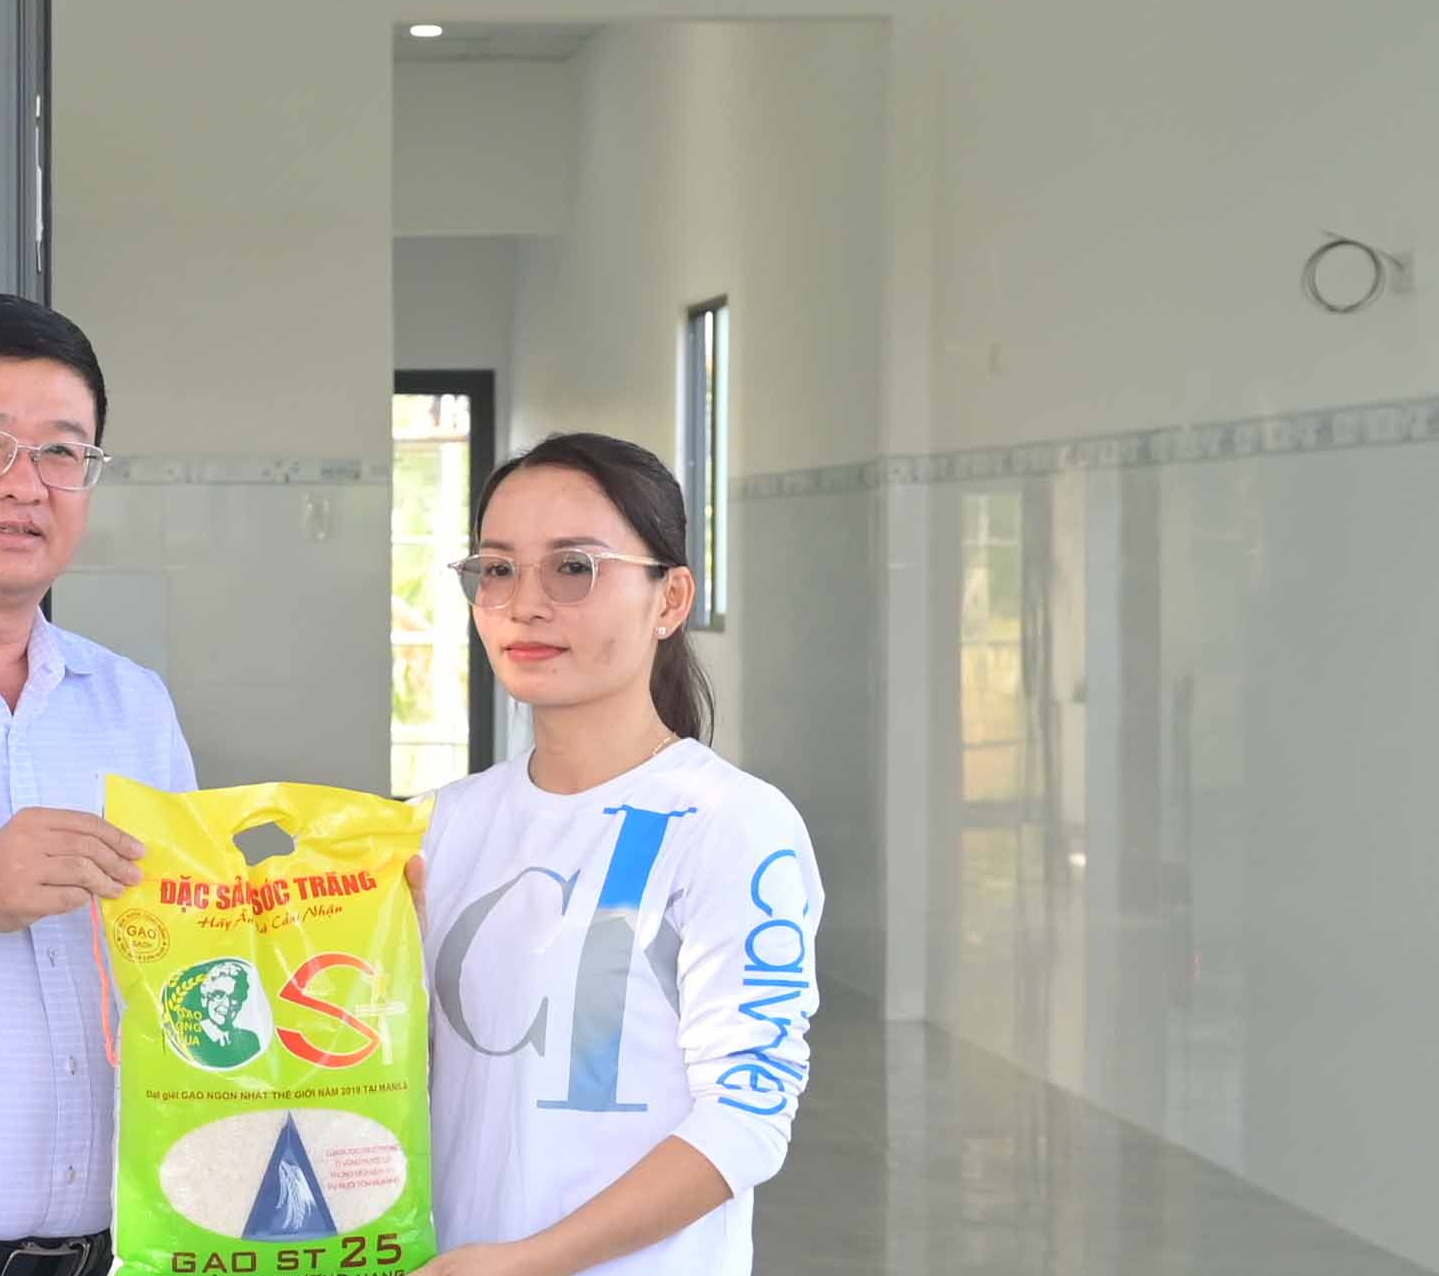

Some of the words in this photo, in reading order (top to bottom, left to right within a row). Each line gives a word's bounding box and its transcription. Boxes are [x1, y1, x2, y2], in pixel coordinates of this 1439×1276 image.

[160, 875, 210, 912] ĐẶC
[252, 878, 290, 915] SÓC
[293, 870, 377, 900] TRĂNG
[276, 1249, 326, 1270] ST
[341, 1233, 403, 1268] 25
